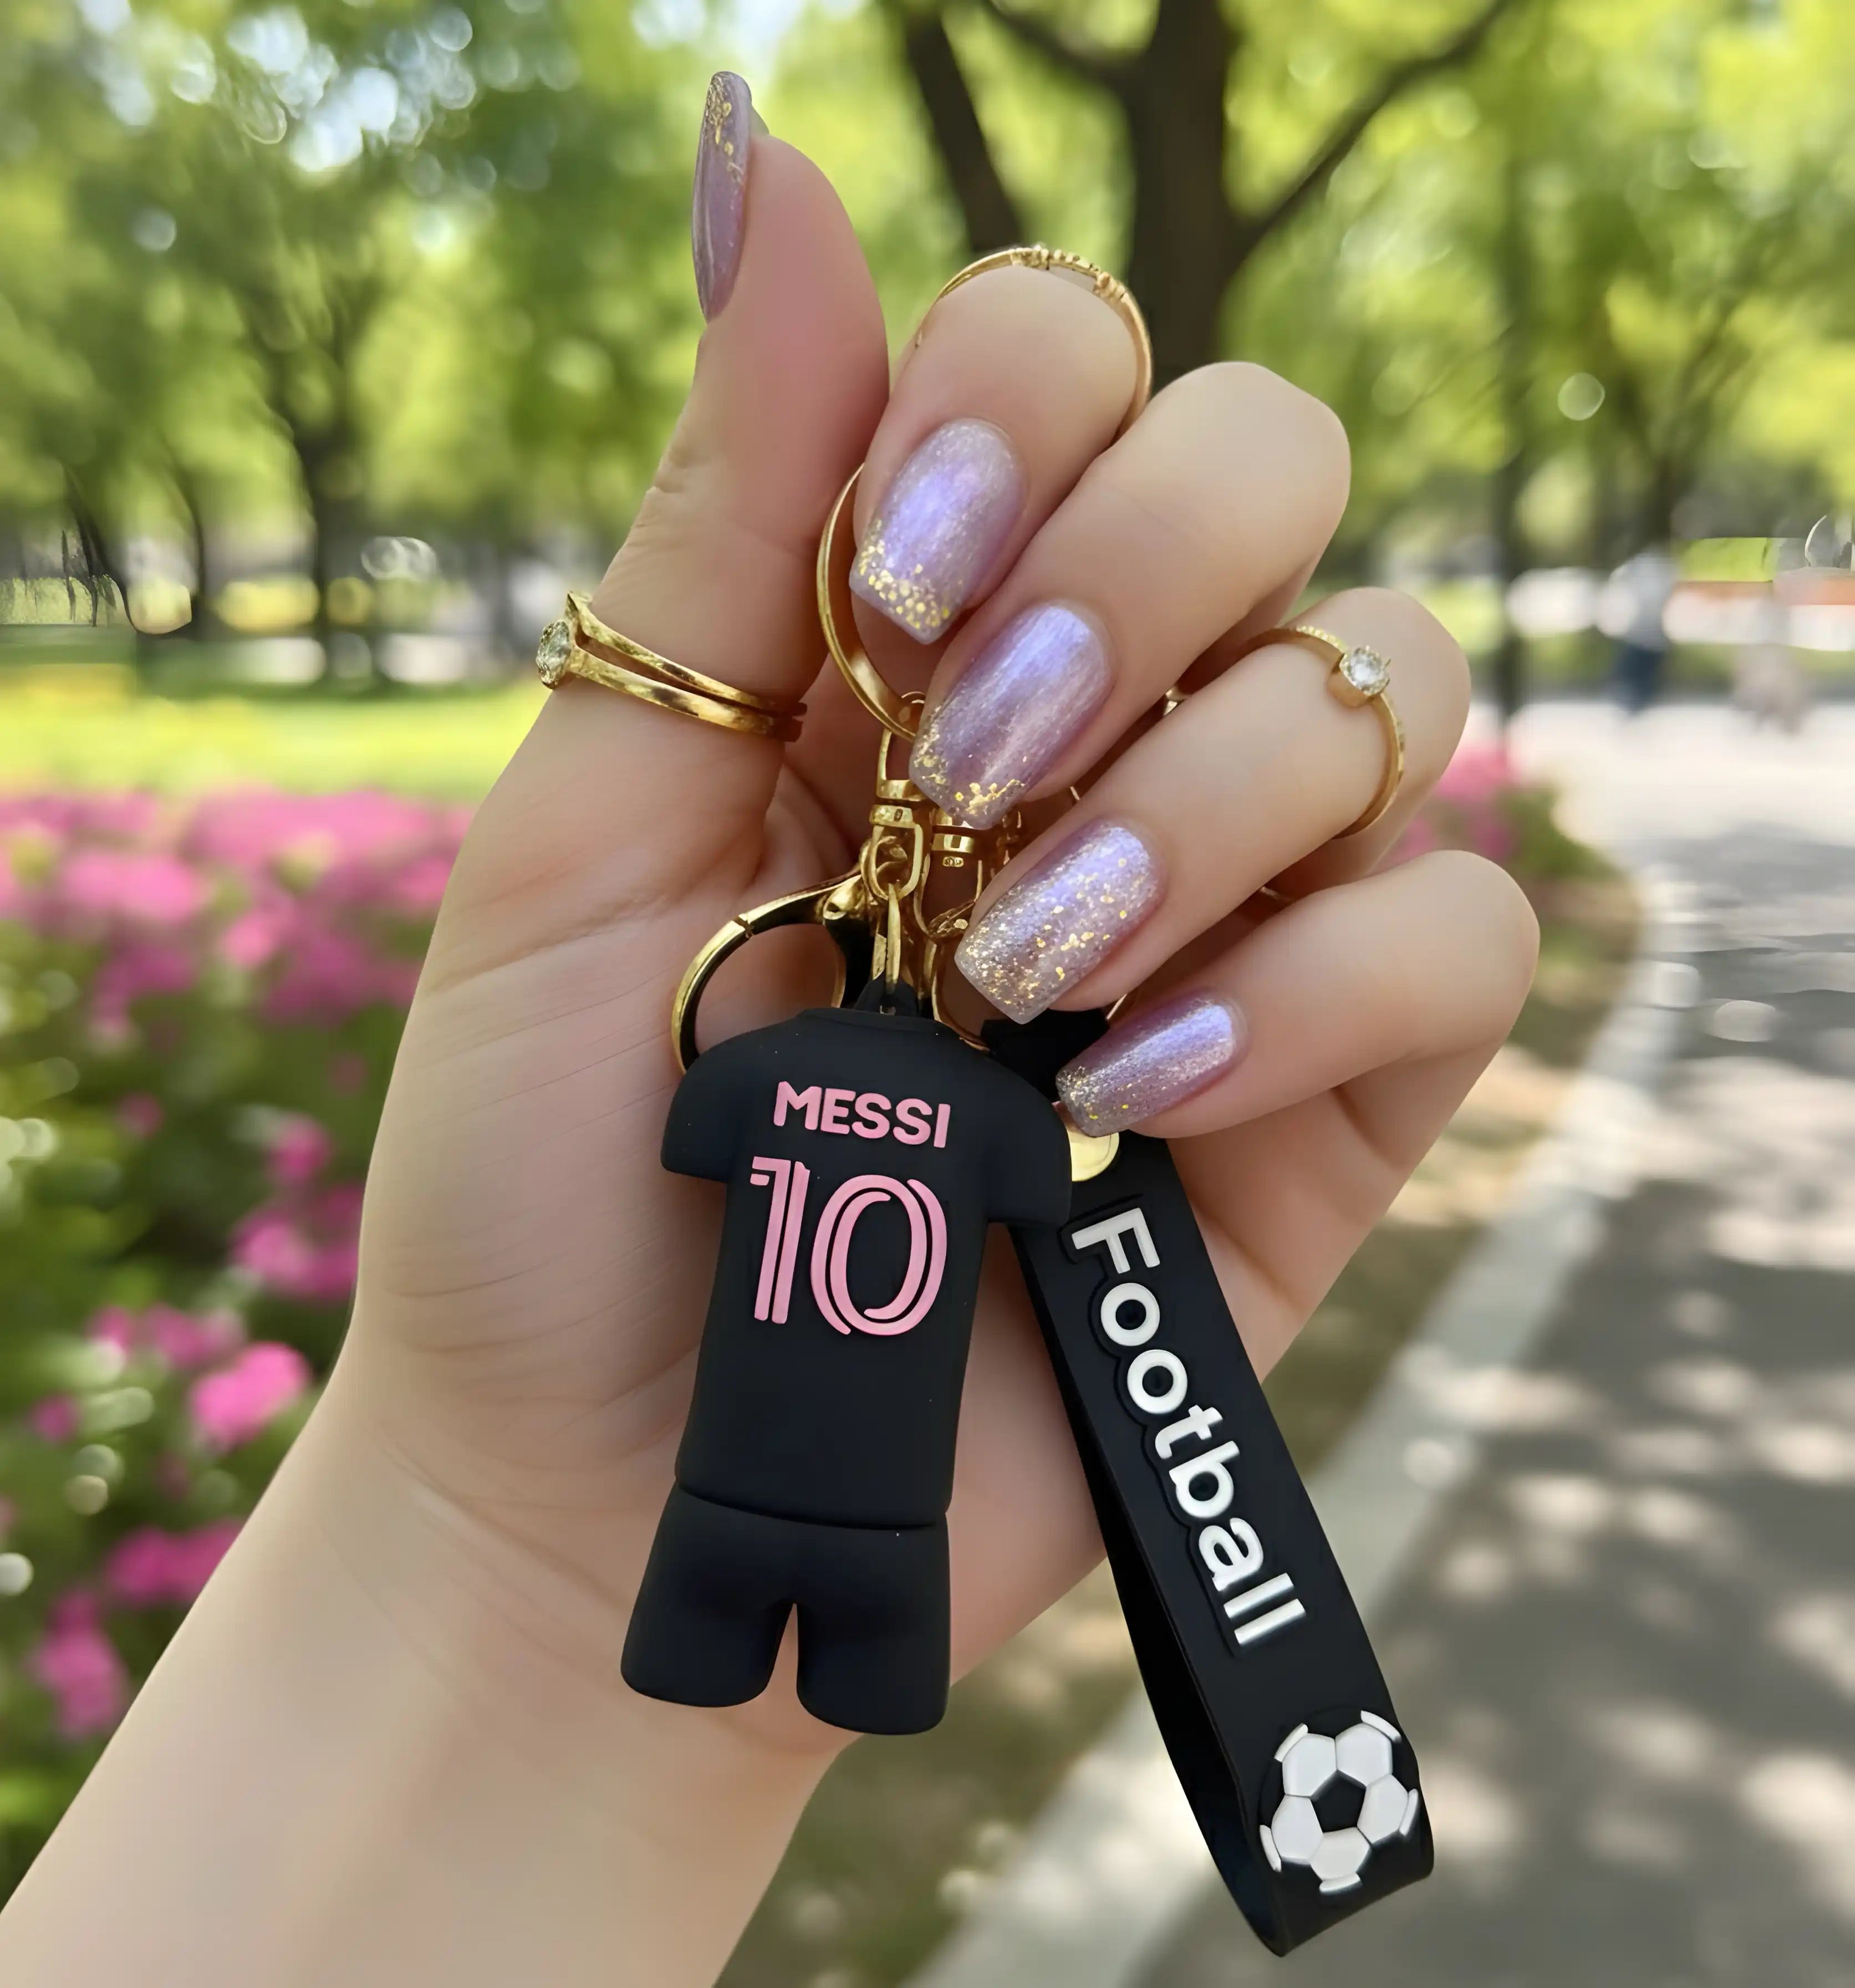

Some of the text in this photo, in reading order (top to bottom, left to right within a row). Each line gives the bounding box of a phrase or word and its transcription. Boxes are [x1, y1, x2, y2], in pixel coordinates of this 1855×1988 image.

[773, 1081, 951, 1148] MESSI
[750, 1156, 947, 1335] 10
[1072, 1207, 1305, 1645] Football
